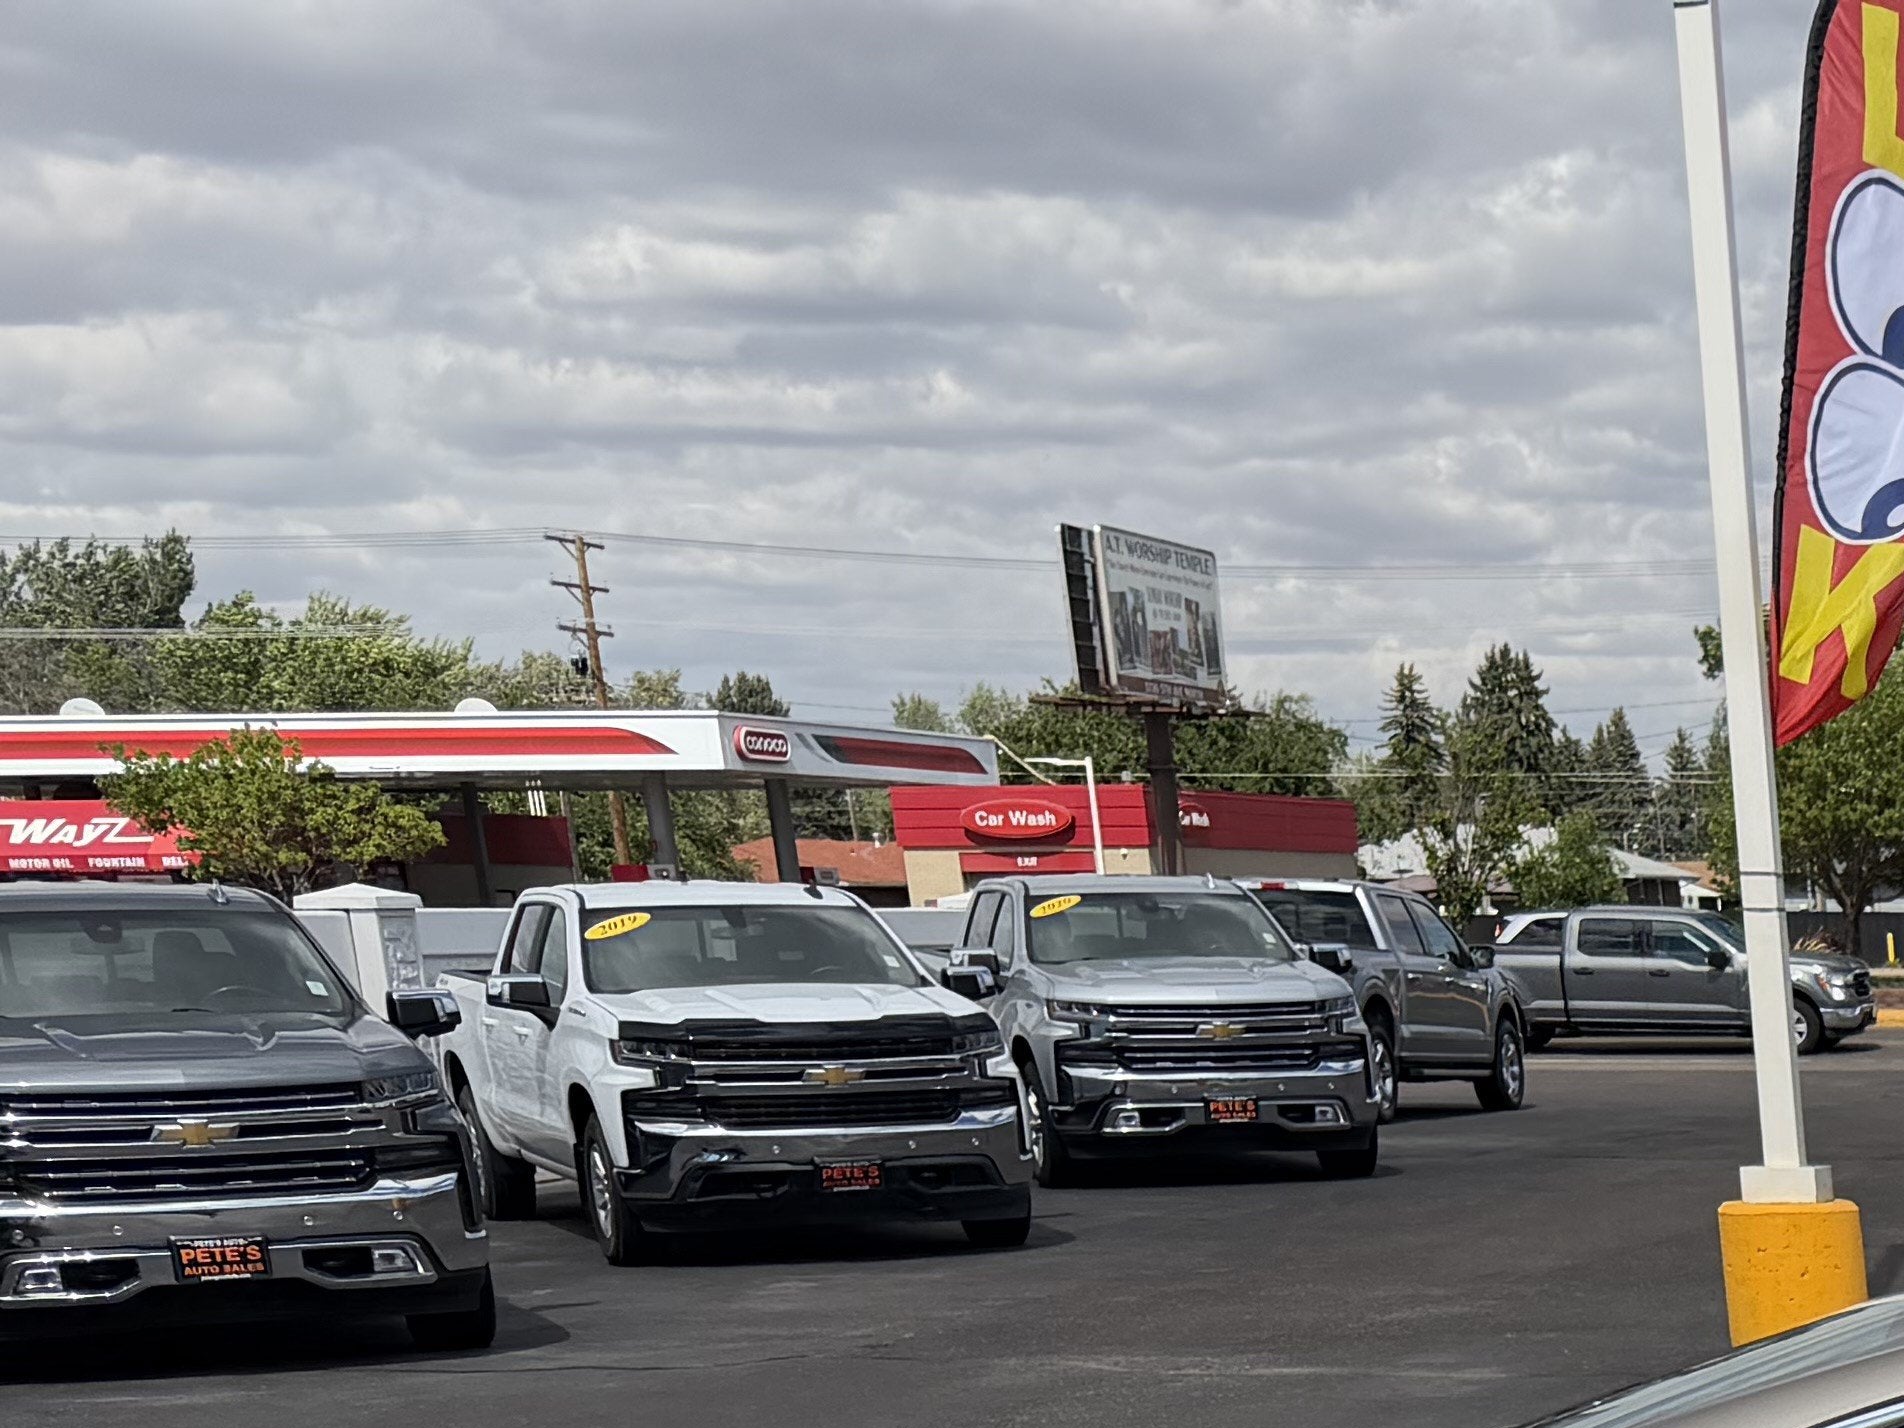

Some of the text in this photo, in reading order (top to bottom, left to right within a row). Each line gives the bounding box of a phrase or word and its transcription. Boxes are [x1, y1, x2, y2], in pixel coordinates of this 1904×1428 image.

[1124, 539, 1172, 565] WORSHIP
[1173, 549, 1212, 576] TEMPLE
[974, 809, 1057, 827] Car Wash
[8, 857, 50, 869] MOTOR
[87, 856, 146, 868] FOUNTAIN
[599, 914, 637, 936] 2019
[180, 1244, 262, 1265] PETE'S
[184, 1261, 265, 1276] AUTO SALES
